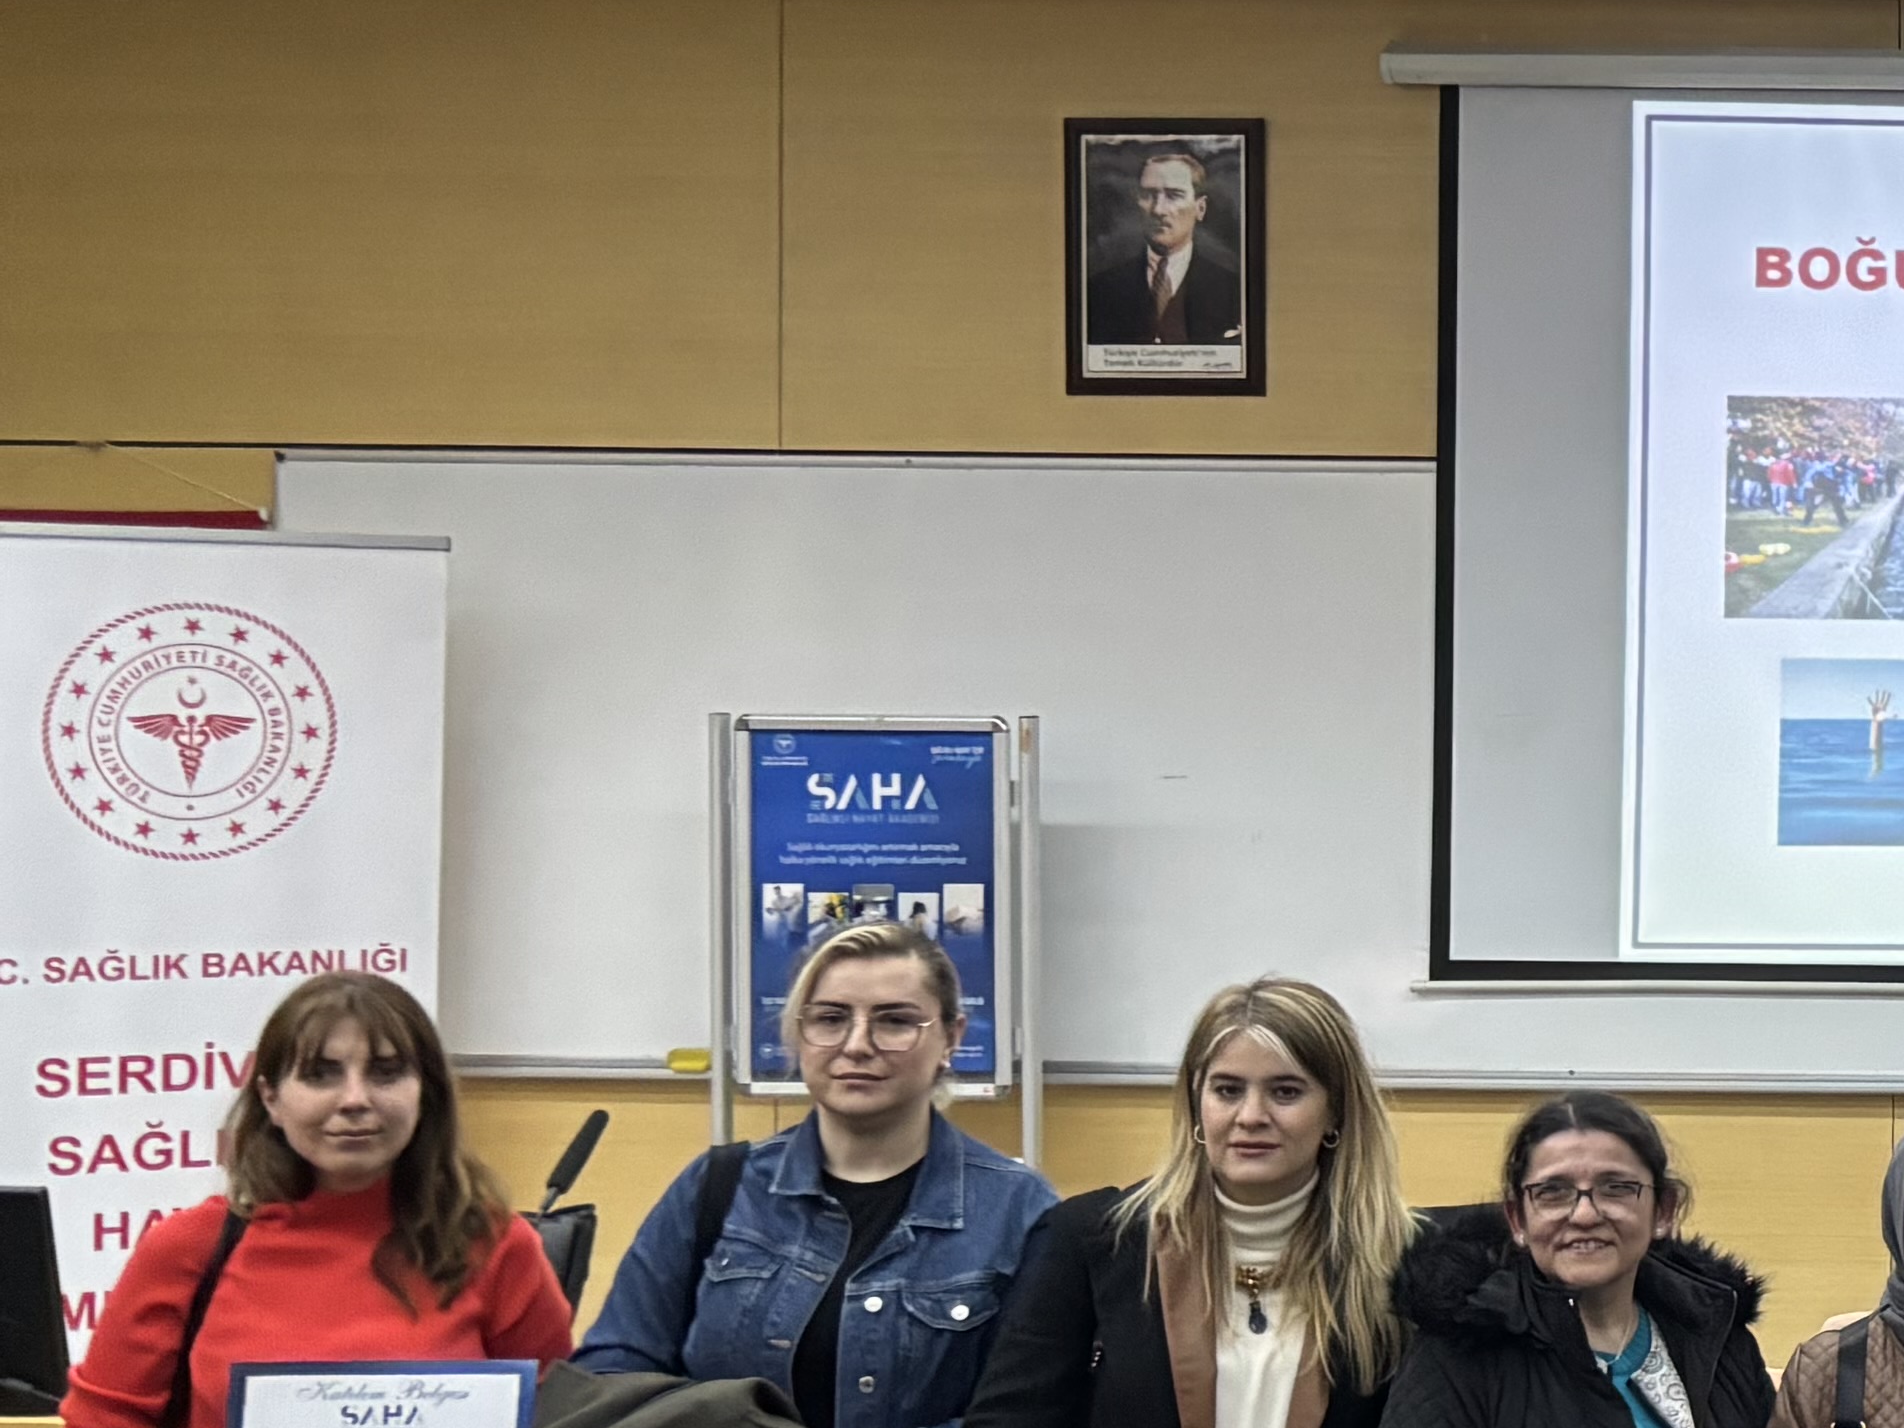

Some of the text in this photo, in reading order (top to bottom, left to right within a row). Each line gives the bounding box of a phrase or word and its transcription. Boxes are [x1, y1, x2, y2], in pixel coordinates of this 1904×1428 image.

[213, 653, 275, 704] SAĞLIK
[235, 706, 286, 800] BAKANLIĞI
[807, 772, 939, 811] SAHA
[43, 949, 189, 984] SAĞLIK
[201, 942, 408, 979] BAKANLIĞI
[35, 1041, 257, 1099] SERDİV
[341, 1404, 424, 1426] SAHA
